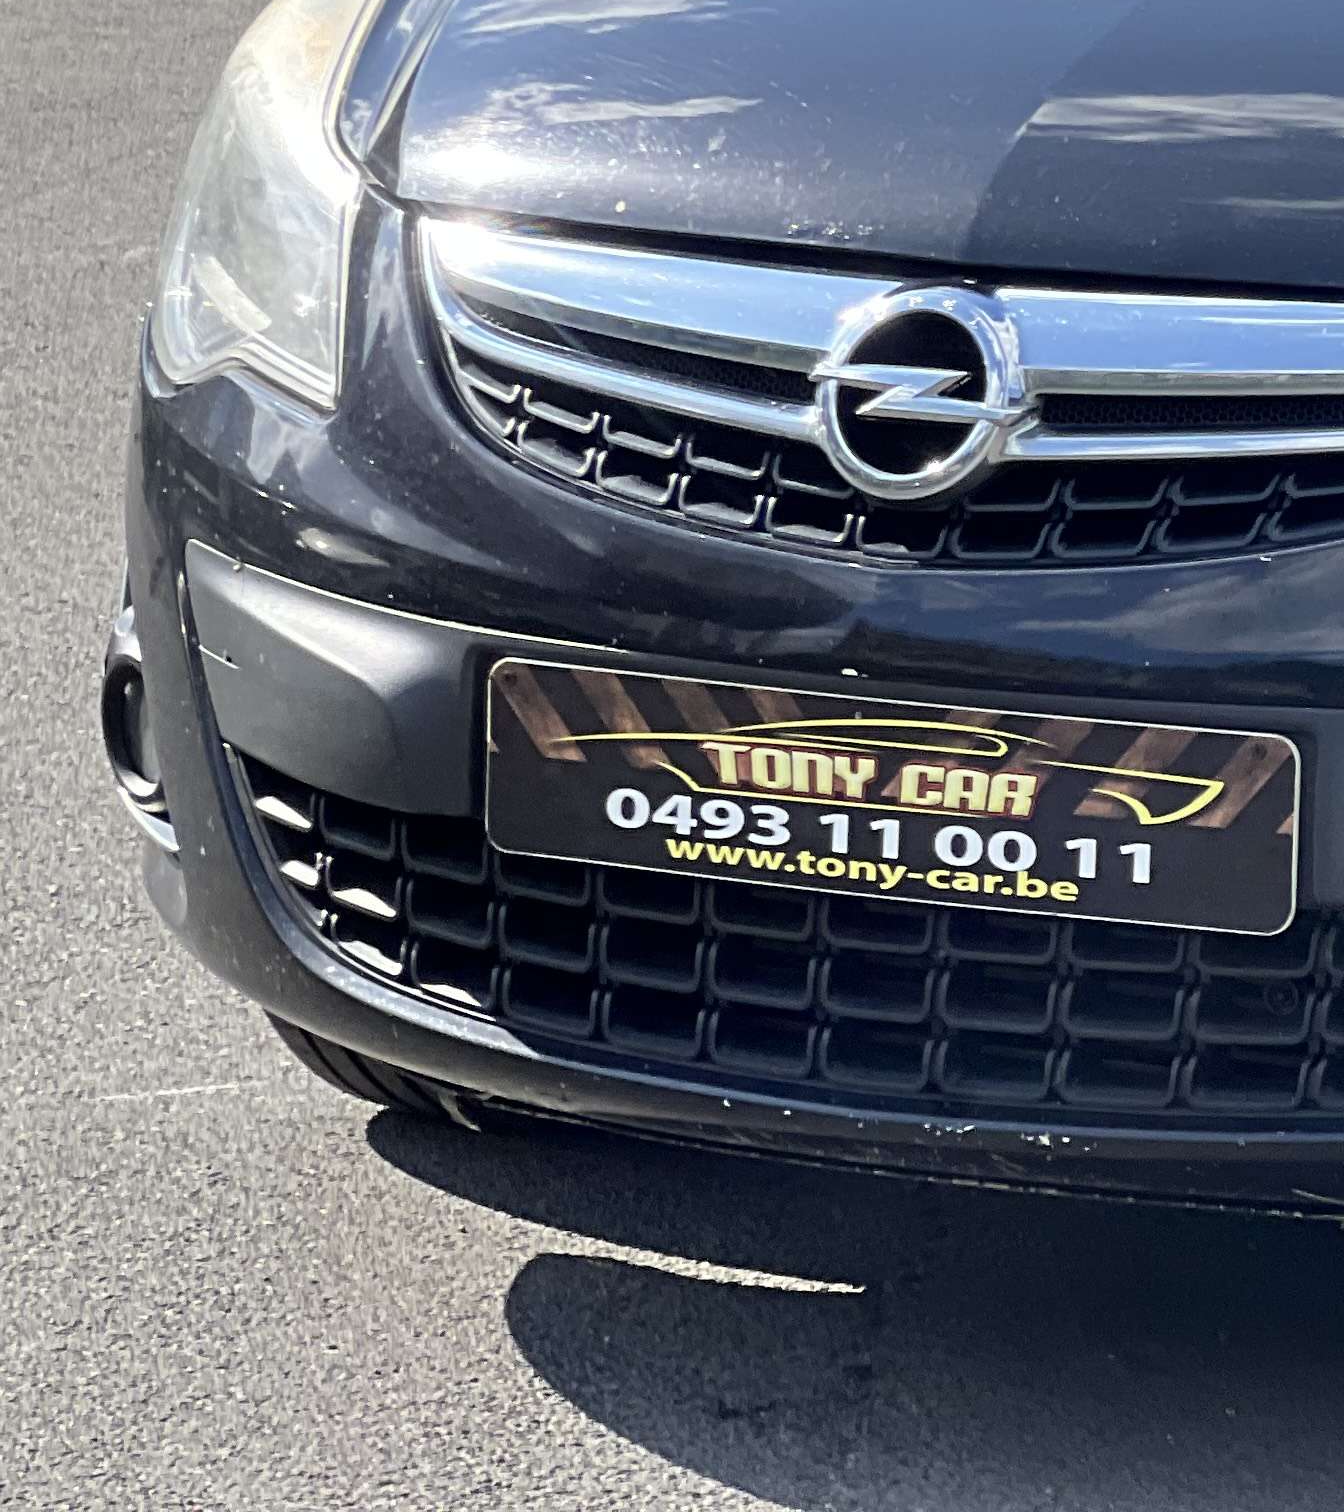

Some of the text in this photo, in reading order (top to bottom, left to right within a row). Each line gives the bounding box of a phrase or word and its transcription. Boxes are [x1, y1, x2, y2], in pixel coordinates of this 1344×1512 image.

[700, 741, 1038, 817] TONY CAR
[606, 787, 1151, 884] 0493 11 00 11
[665, 838, 1080, 902] www.tony-car.be
